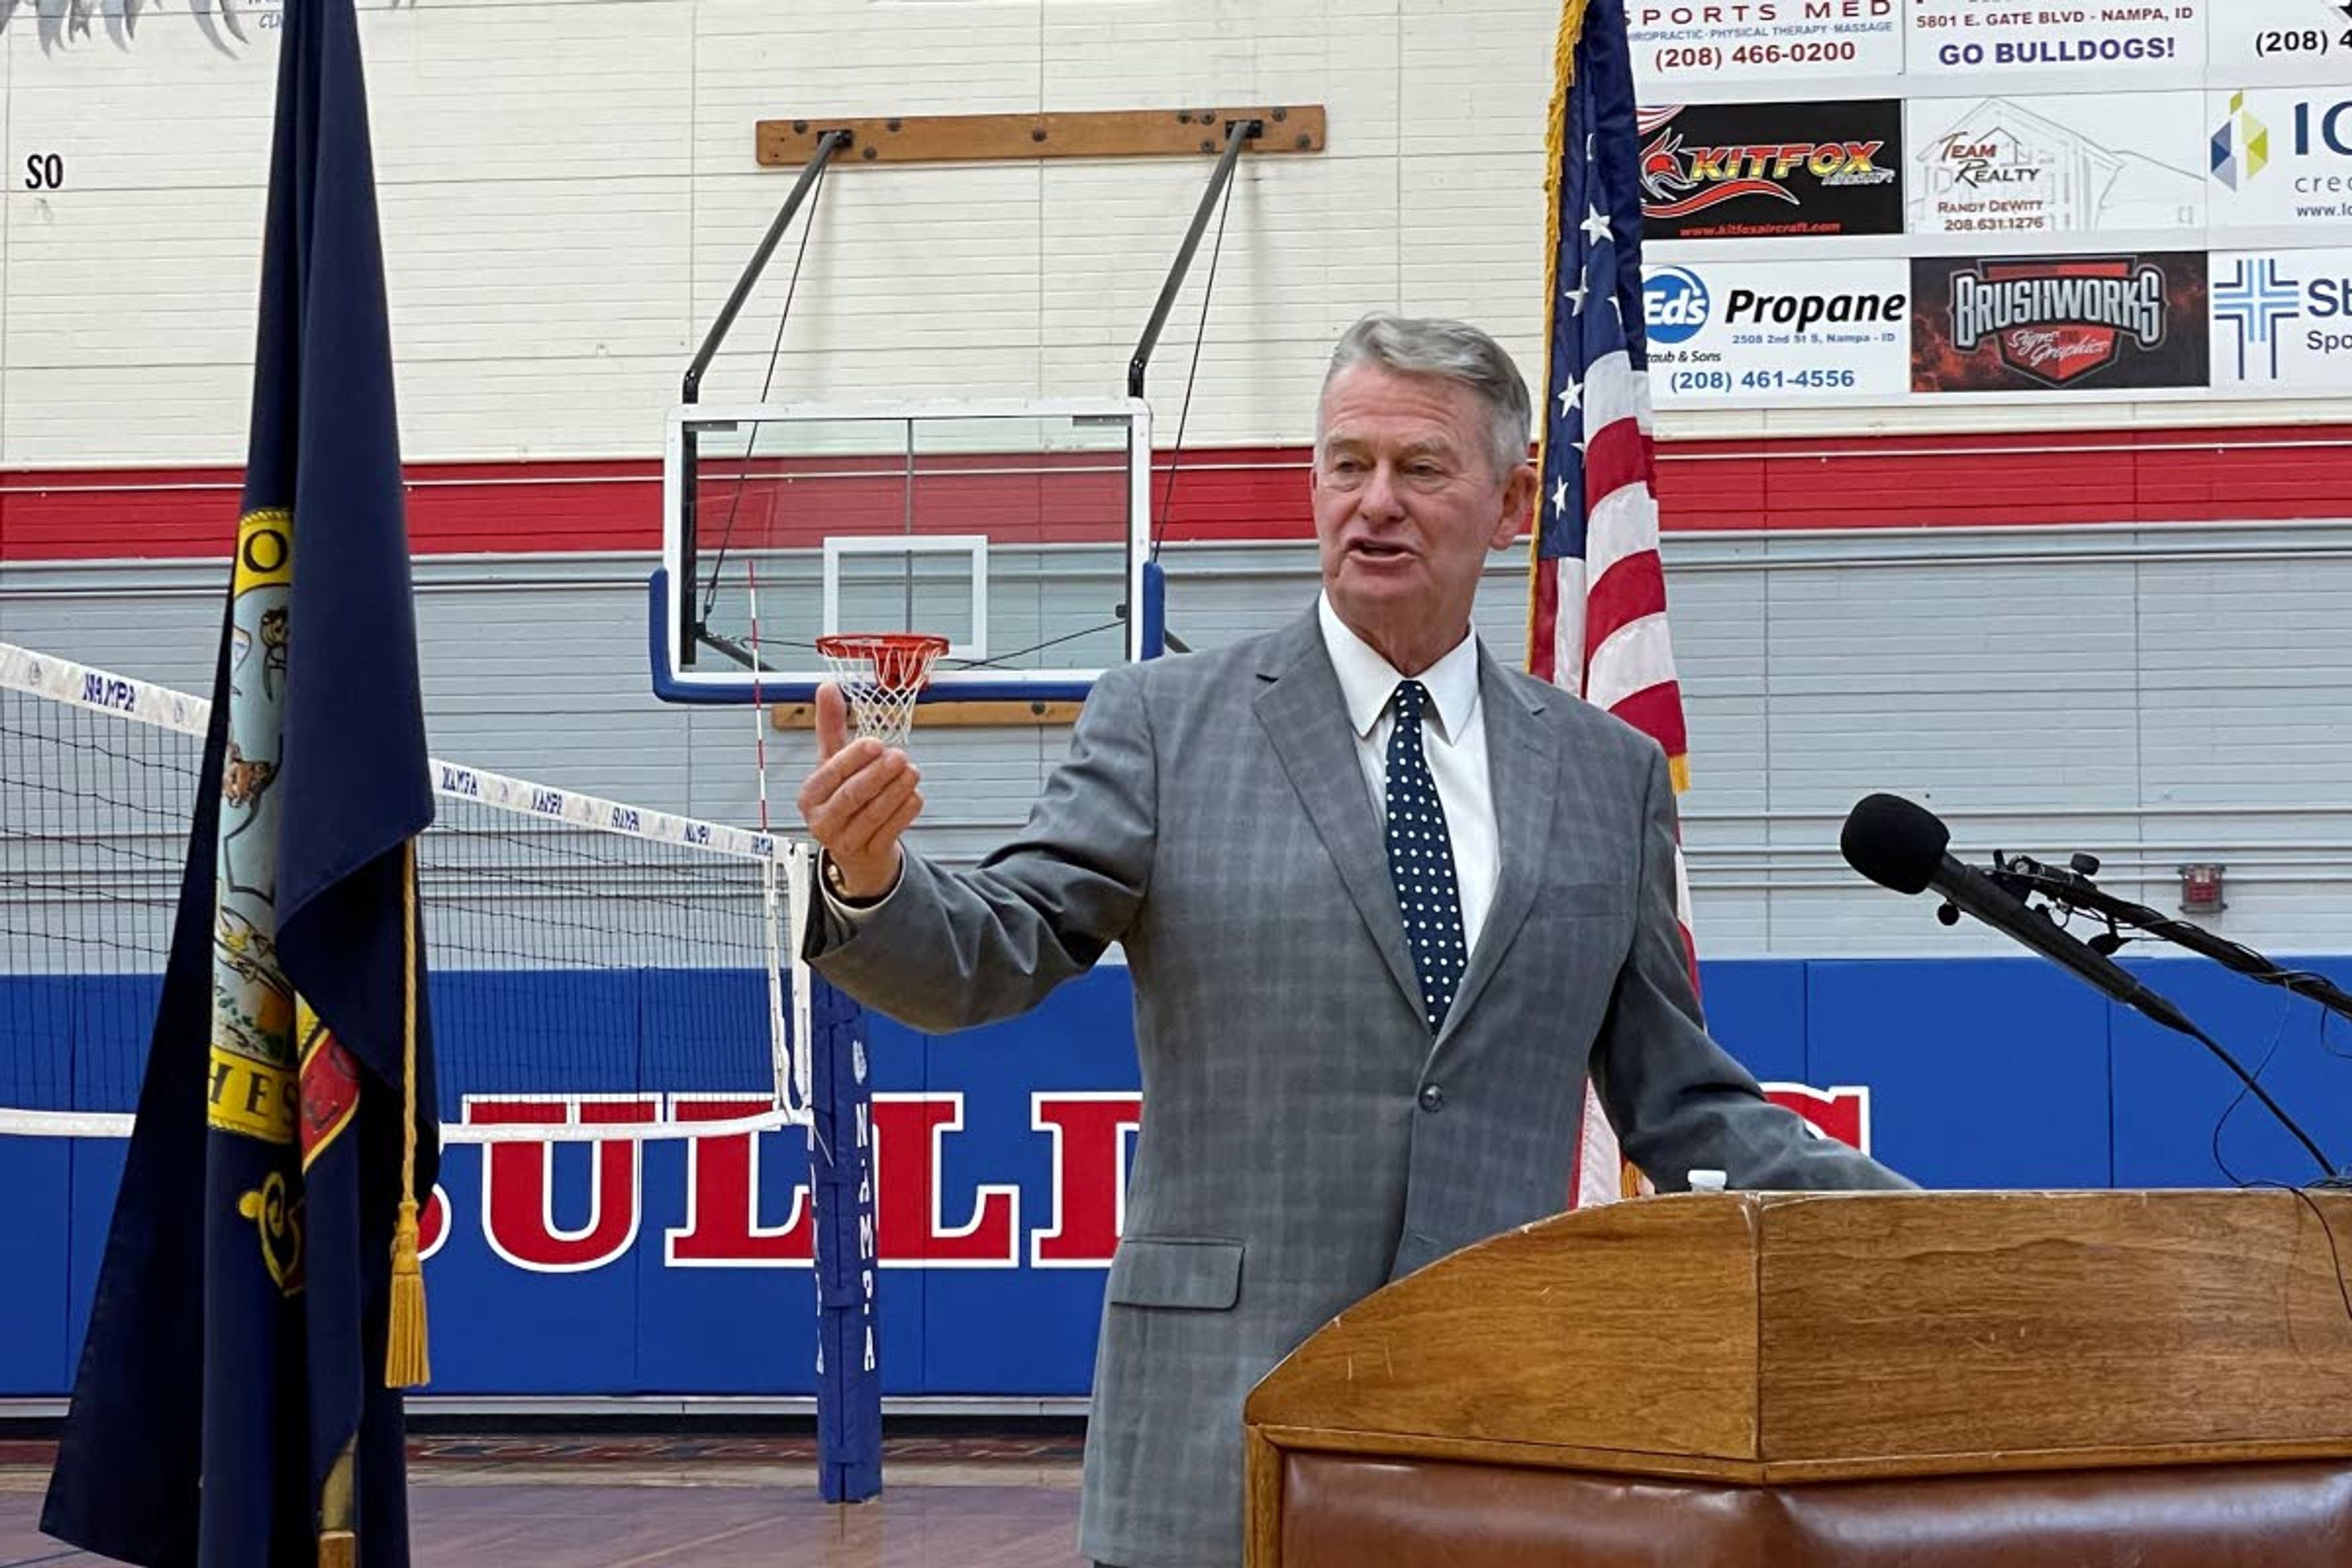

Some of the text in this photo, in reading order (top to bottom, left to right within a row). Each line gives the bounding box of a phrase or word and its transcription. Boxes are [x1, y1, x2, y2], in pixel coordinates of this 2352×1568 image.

[1805, 0, 1890, 18] MED
[1917, 15, 1956, 28] 5801
[1964, 13, 1980, 26] E.
[1986, 12, 2032, 25] GATE
[2038, 10, 2084, 24] BLVD
[2101, 8, 2169, 22] NAMPA,
[2176, 7, 2193, 19] ID
[1711, 27, 1768, 38] PHYSICAL
[1772, 24, 1828, 36] THERAPY
[1833, 21, 1893, 33] MASSAGE
[1939, 37, 2174, 66] GO BULLDOGS!
[2256, 30, 2328, 58] (208)
[1656, 41, 1855, 72] (208) 466-0200
[25, 154, 62, 189] SO
[1684, 141, 1885, 182] KITFOX
[1954, 159, 2040, 189] REALTY
[1938, 202, 1985, 213] RANDY
[1679, 222, 1841, 238] www.kitfoxaircraft.com
[1944, 217, 2044, 231] 208.631.1276
[1725, 289, 1906, 333] Propane
[1956, 271, 2160, 347] BRUSHWORKS
[1768, 334, 1790, 344] 2nd
[1826, 333, 1869, 344] Nampa
[1882, 333, 1896, 342] ID
[1678, 351, 1688, 362] &
[1691, 351, 1722, 363] Sons
[1672, 370, 1855, 394] (208) 461-4556
